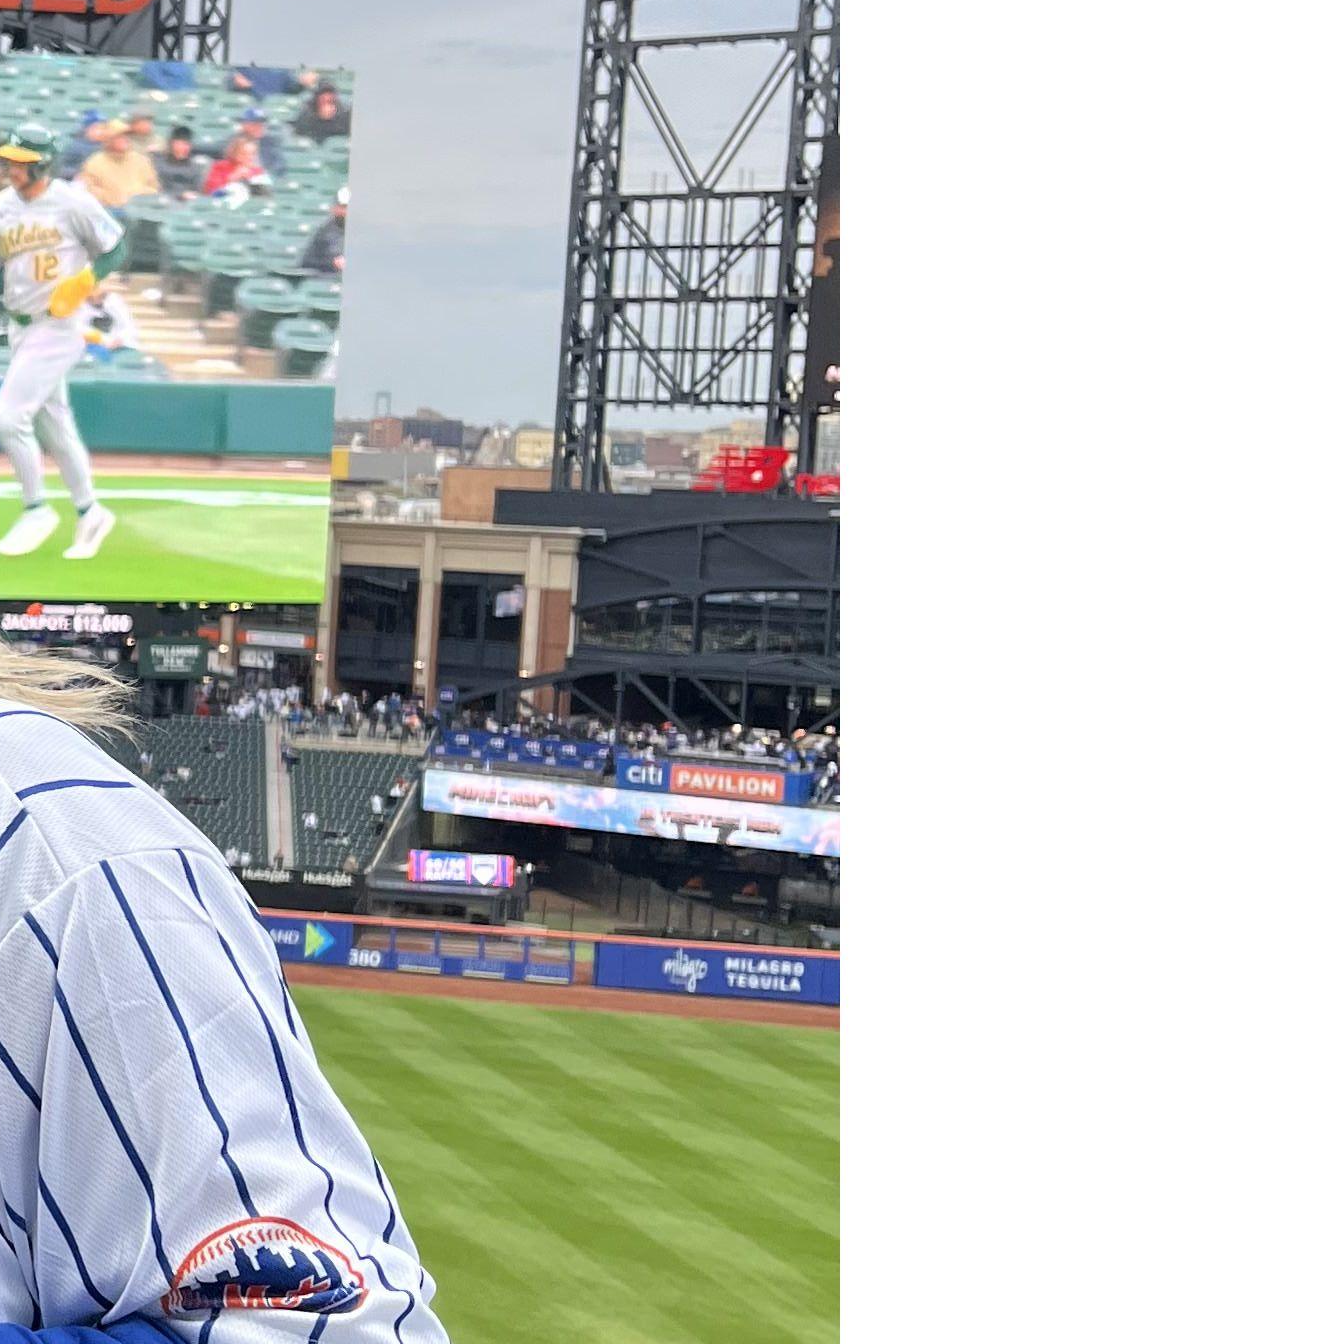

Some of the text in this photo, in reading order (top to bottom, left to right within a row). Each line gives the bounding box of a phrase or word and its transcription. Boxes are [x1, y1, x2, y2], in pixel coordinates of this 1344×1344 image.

[33, 255, 59, 281] 12
[625, 765, 663, 787] citi
[676, 770, 777, 798] PAVILION
[349, 948, 382, 968] 380
[724, 956, 806, 977] MILAGRO
[726, 974, 802, 993] TEQUILA
